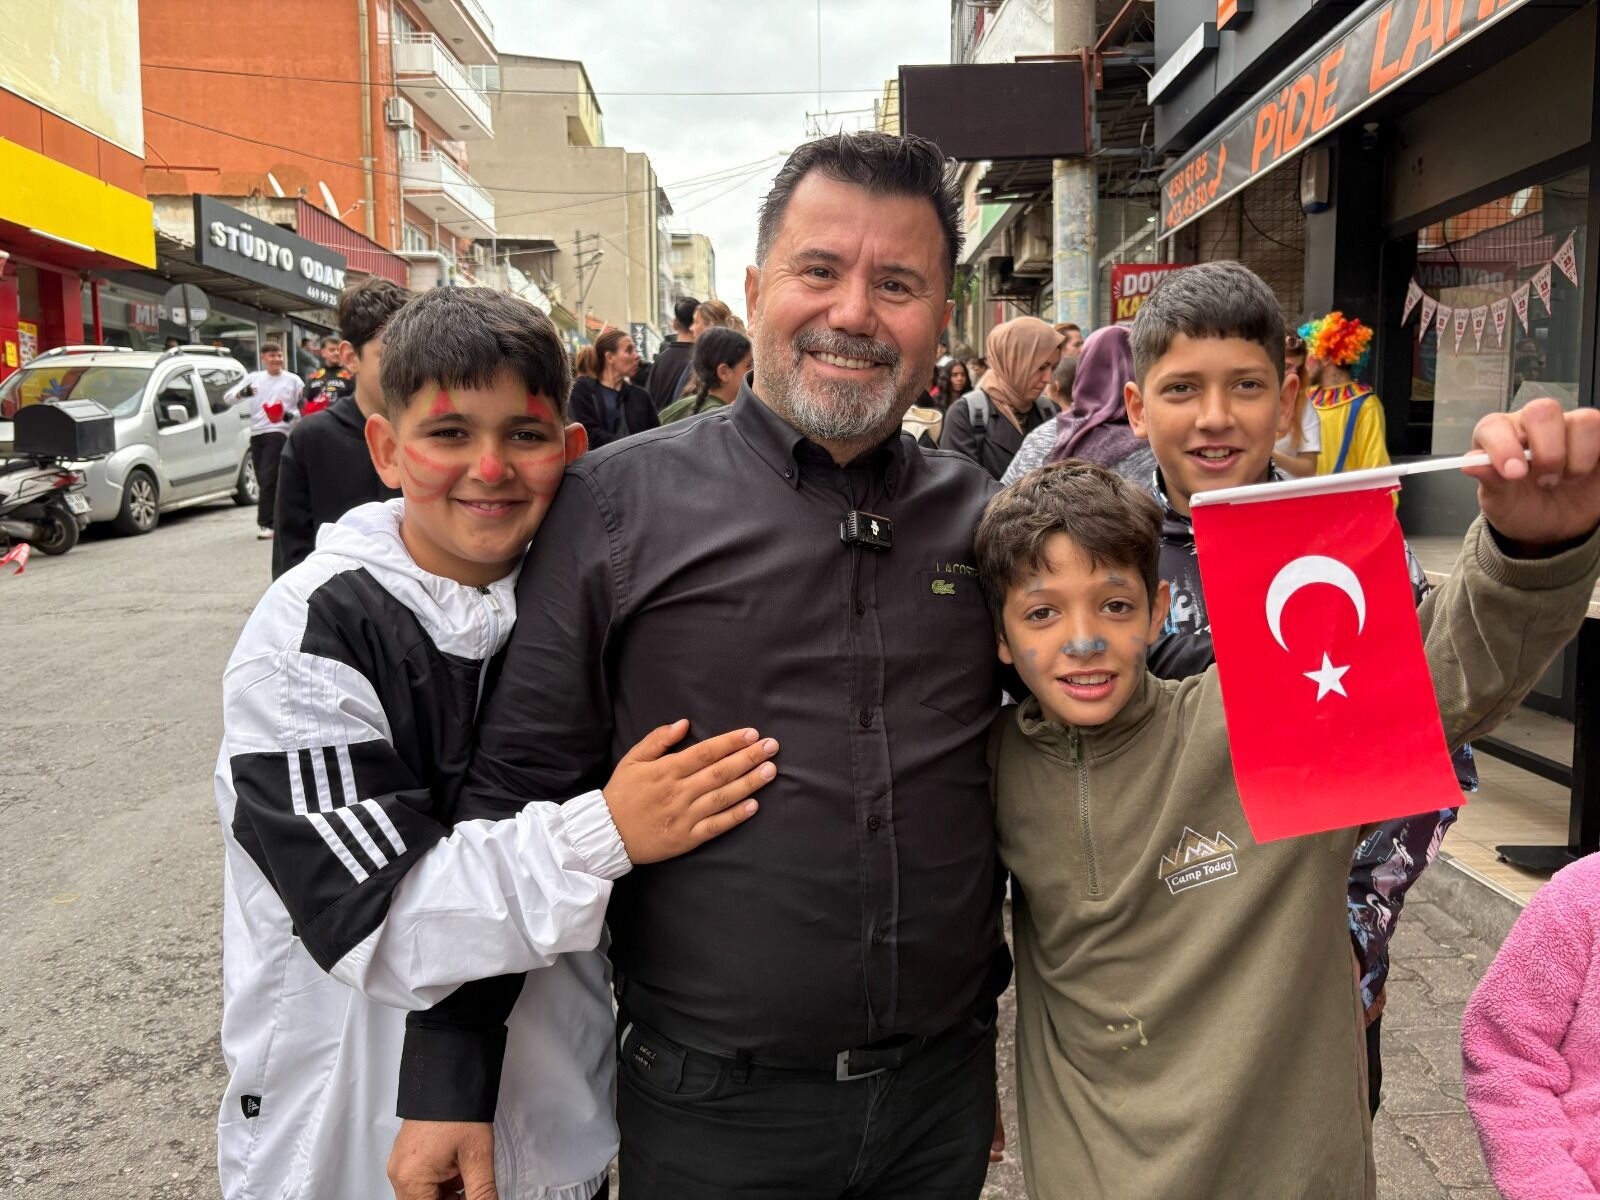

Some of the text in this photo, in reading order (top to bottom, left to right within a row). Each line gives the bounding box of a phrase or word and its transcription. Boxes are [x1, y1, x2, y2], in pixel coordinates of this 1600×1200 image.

[210, 221, 346, 291] STÜDYO ODAK
[1171, 860, 1232, 886] Camp Today
